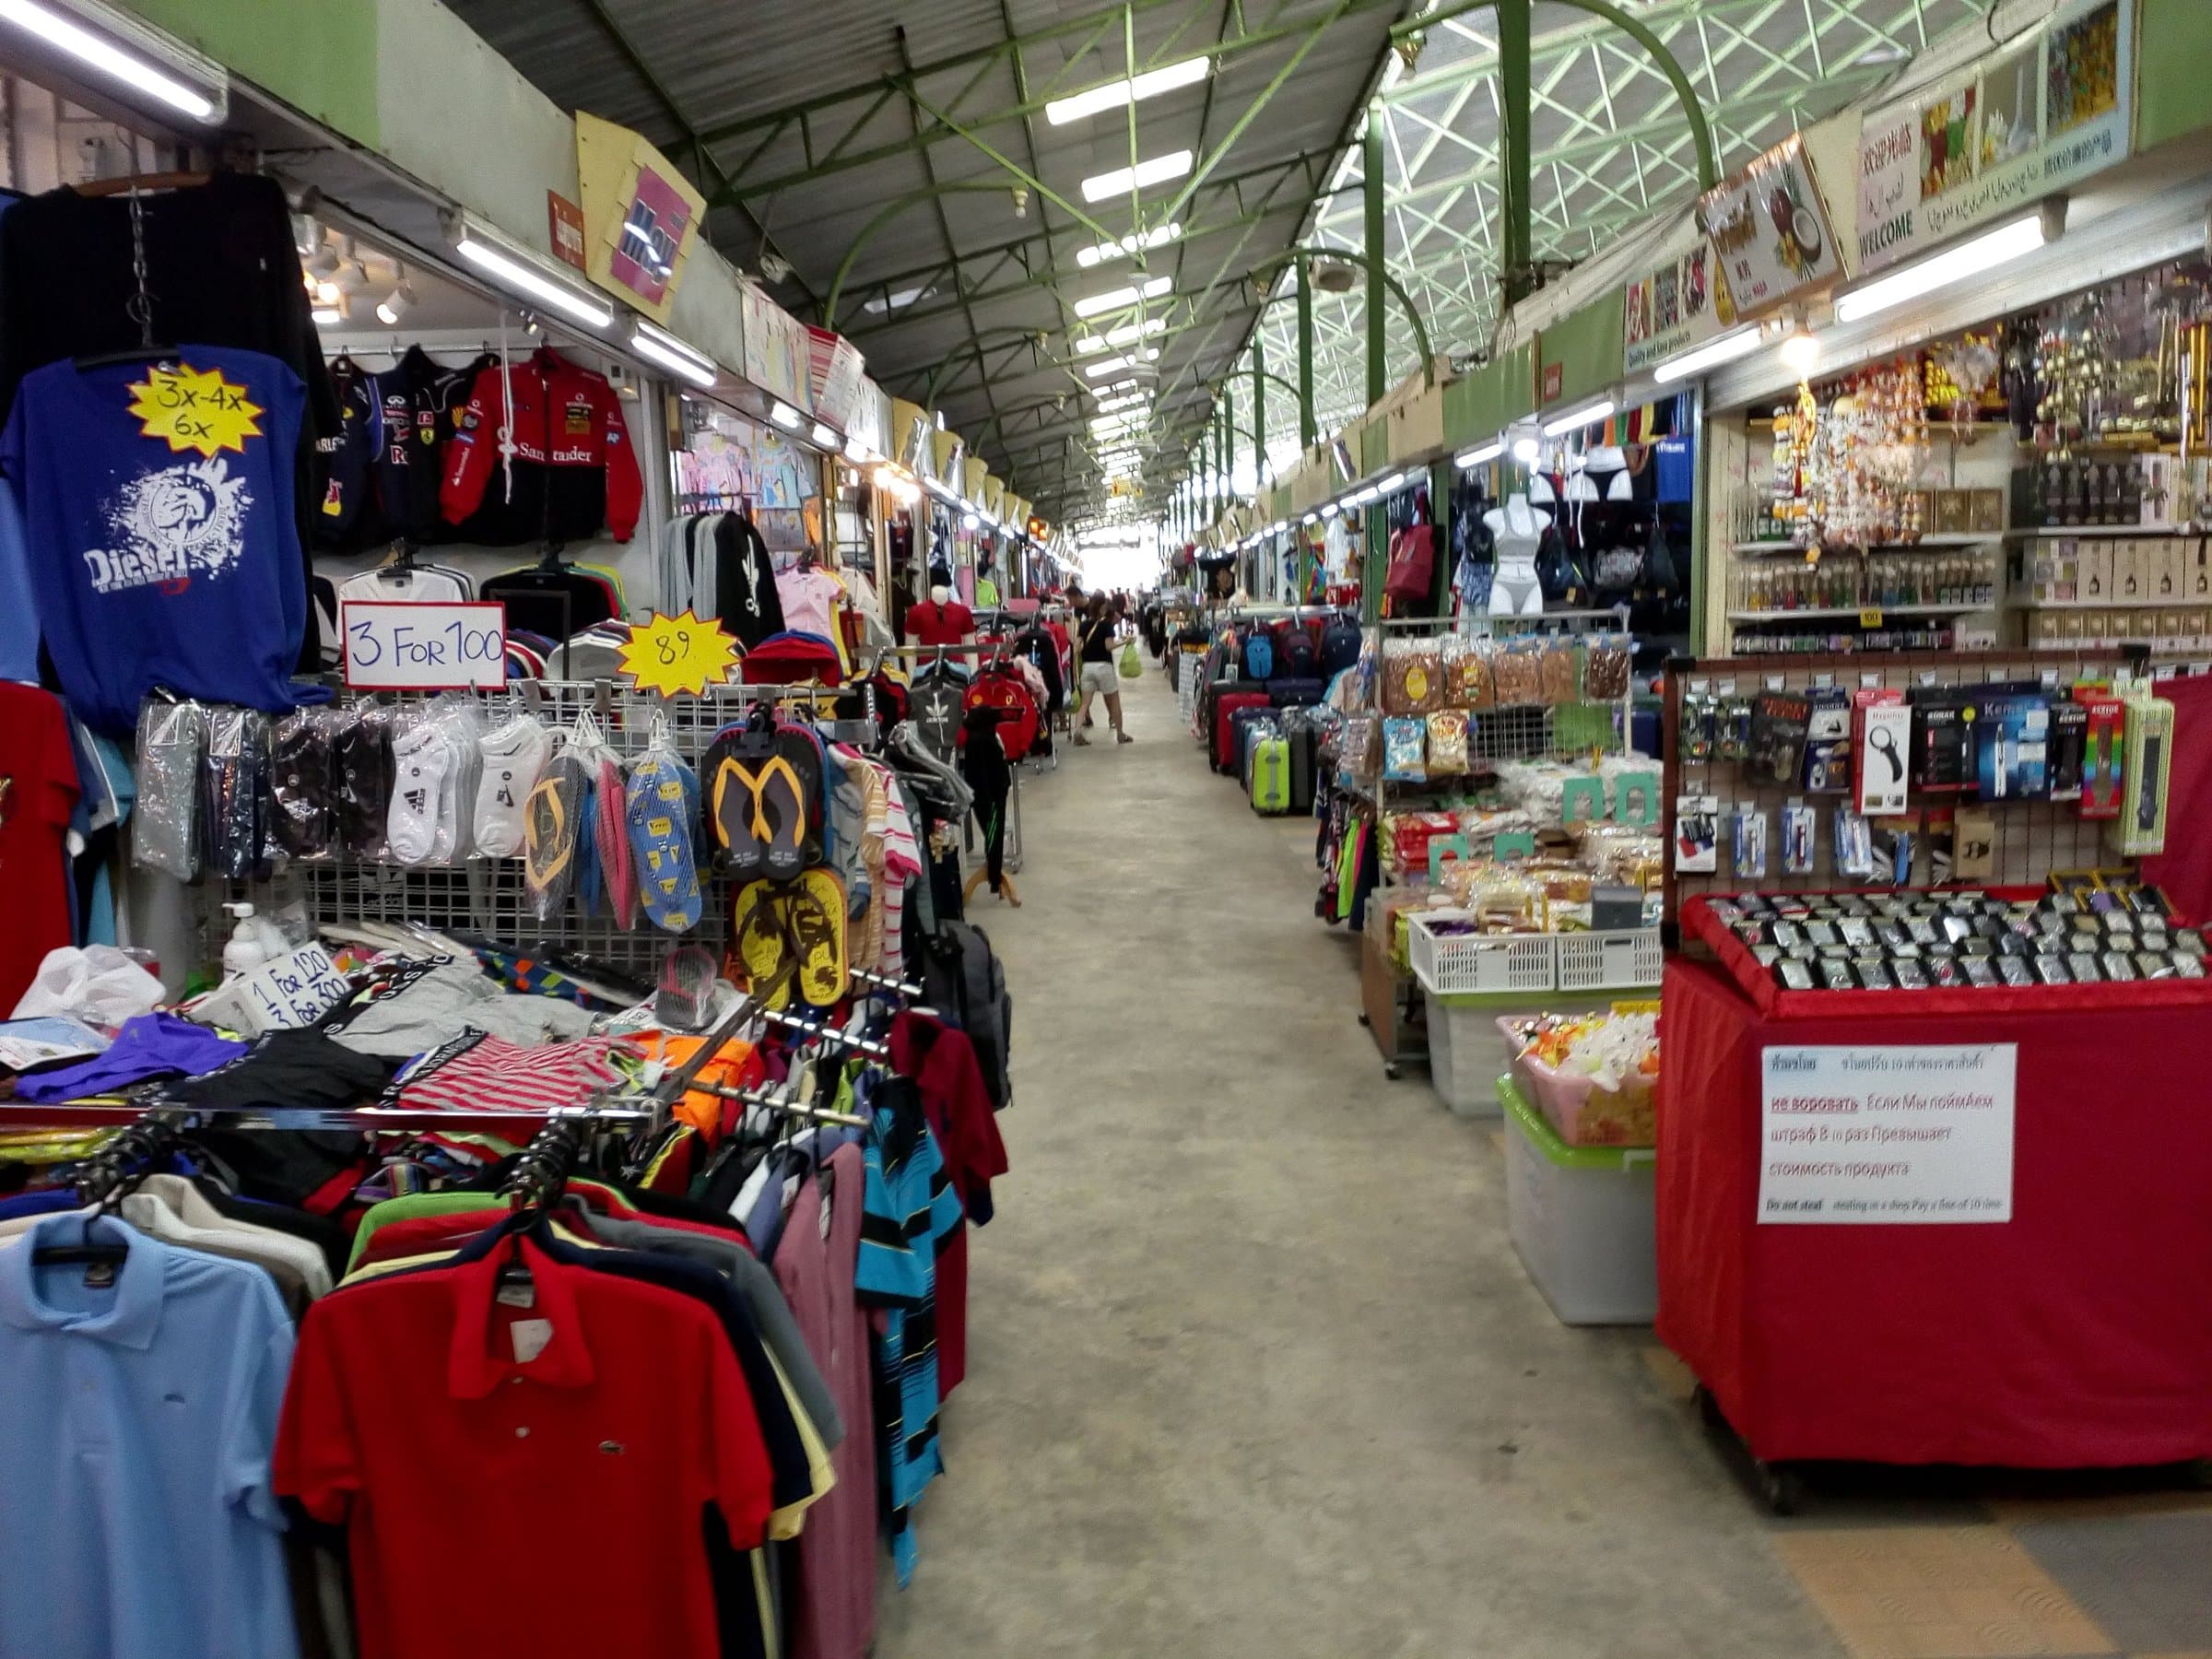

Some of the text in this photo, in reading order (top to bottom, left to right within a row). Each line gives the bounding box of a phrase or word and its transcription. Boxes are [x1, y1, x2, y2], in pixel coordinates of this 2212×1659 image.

[1859, 208, 1913, 264] WELCOME
[348, 620, 382, 667] 3
[444, 620, 505, 665] 100
[654, 629, 692, 665] 89
[292, 949, 330, 984] 120
[1771, 1097, 1789, 1112] не
[1792, 1096, 1859, 1113] воровать
[1901, 1092, 1926, 1112] Мы
[1771, 1124, 1818, 1145] штраф
[1770, 1161, 1910, 1180] стоимость продукта
